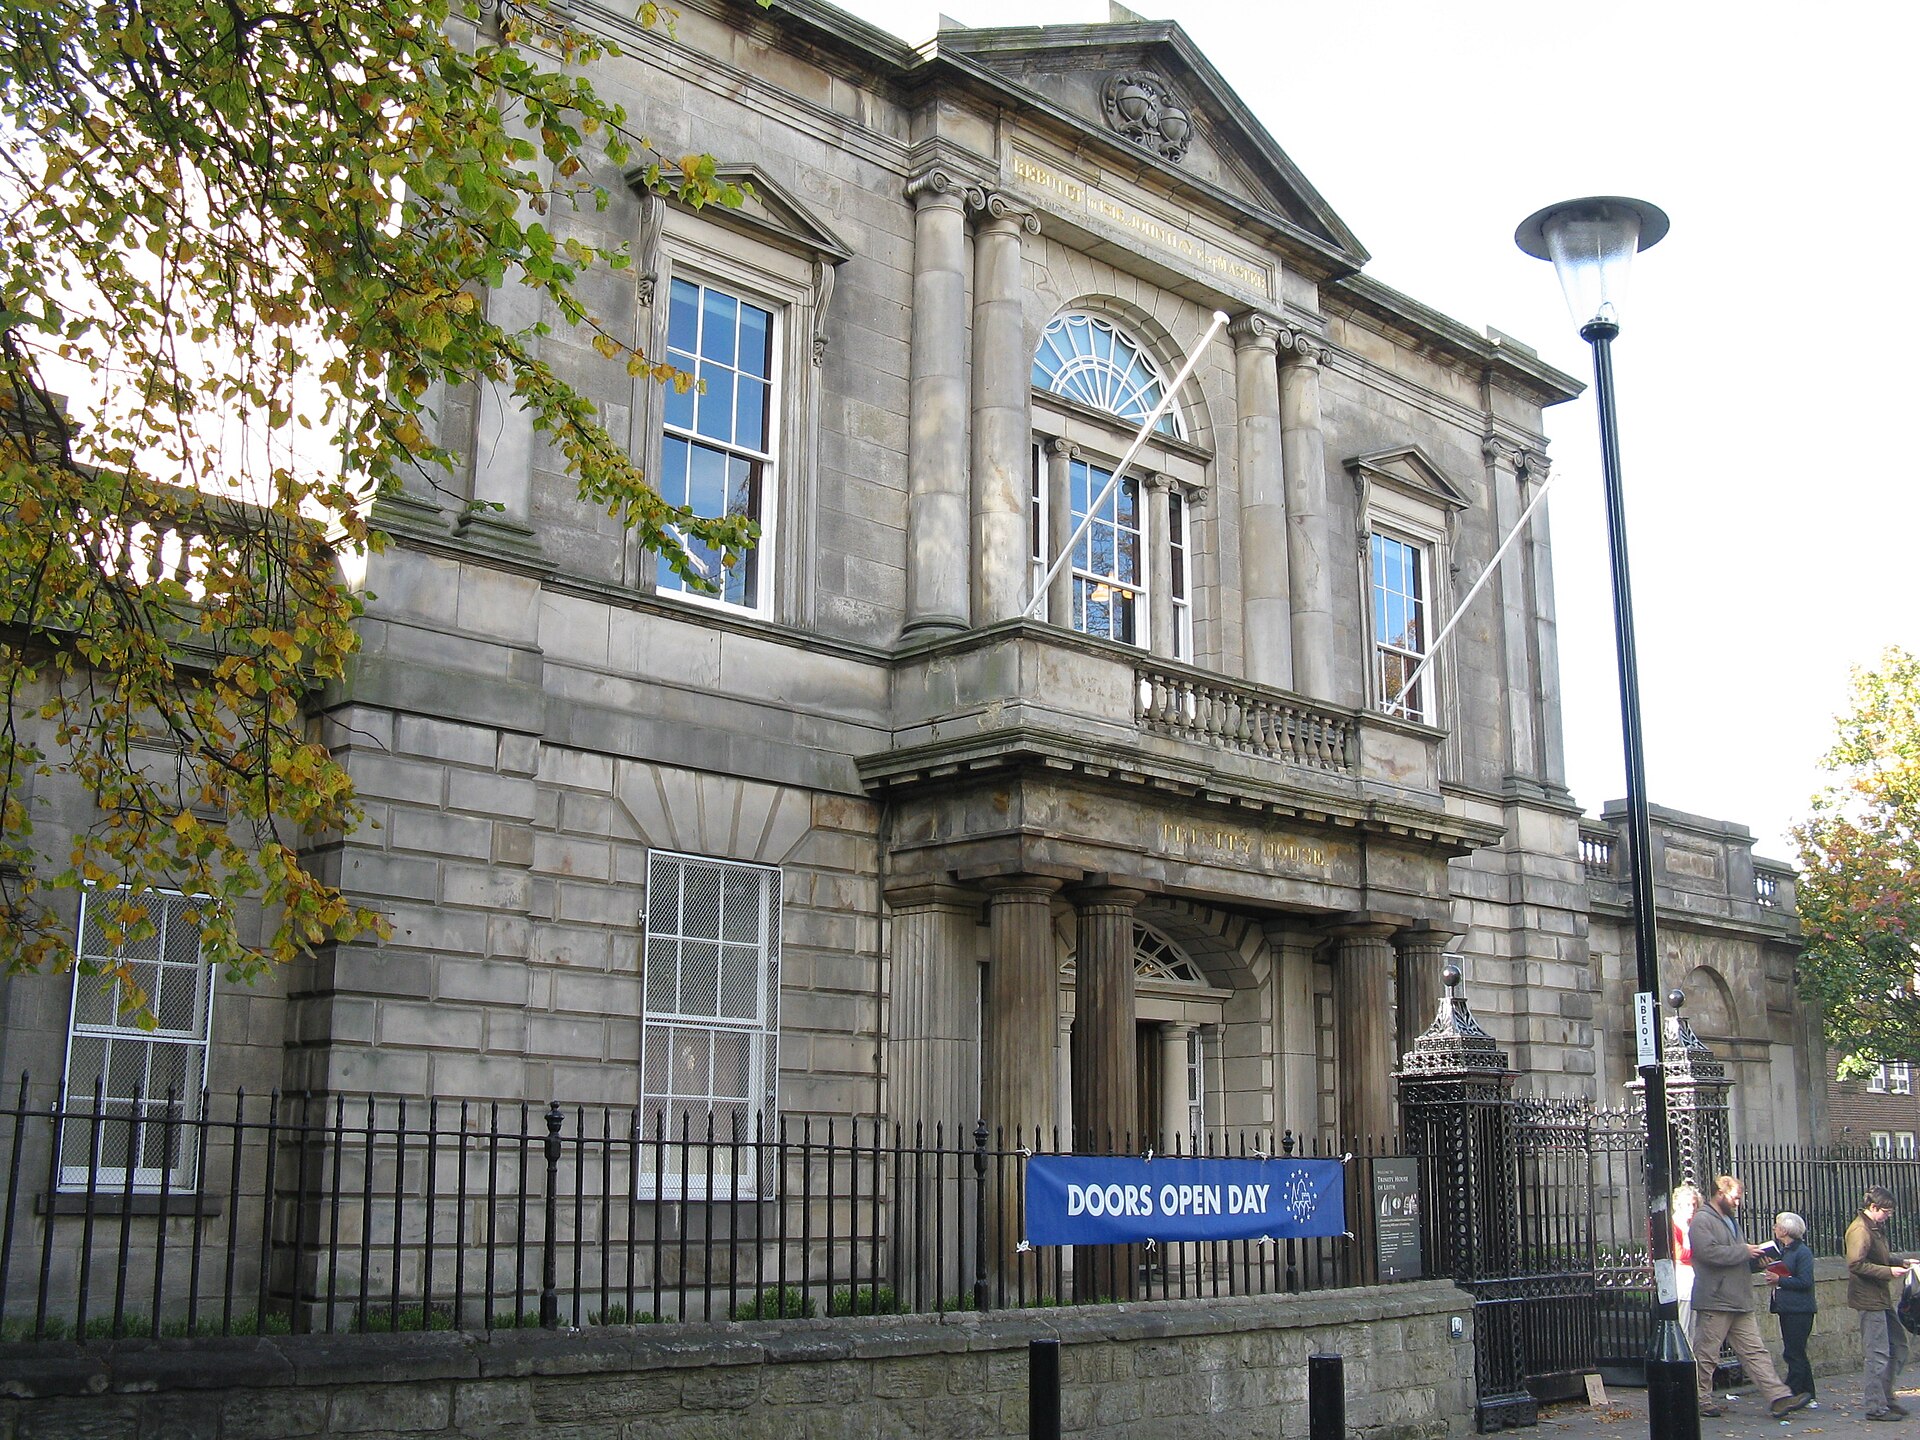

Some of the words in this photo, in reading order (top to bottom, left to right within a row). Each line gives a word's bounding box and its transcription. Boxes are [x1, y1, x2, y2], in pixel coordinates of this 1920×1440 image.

[1013, 157, 1085, 202] REBUILT
[1163, 824, 1255, 854] TRINITY
[1067, 1183, 1153, 1217] DOORS
[1159, 1183, 1221, 1216] OPEN
[1227, 1183, 1271, 1214] DAY
